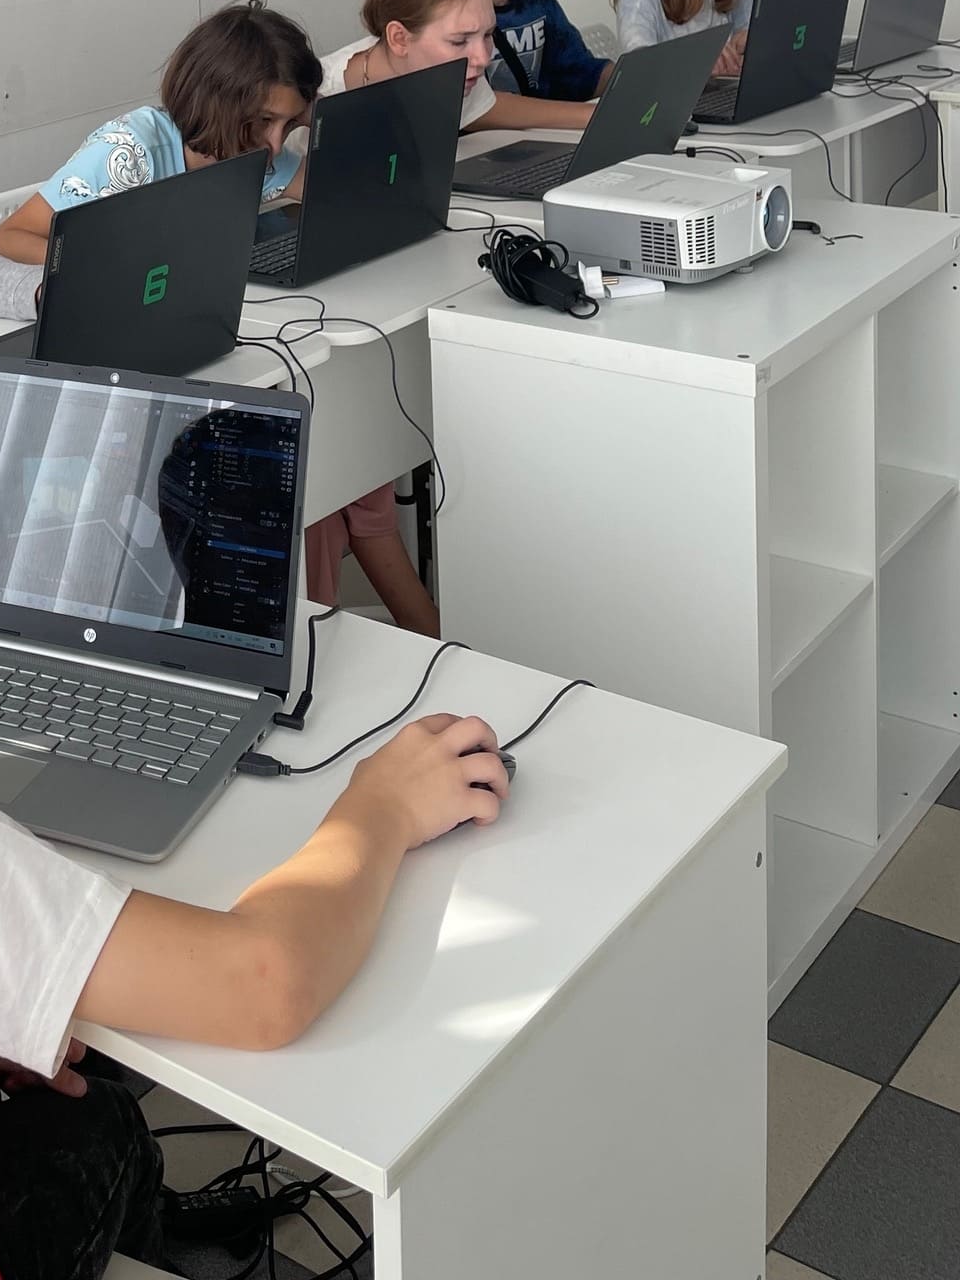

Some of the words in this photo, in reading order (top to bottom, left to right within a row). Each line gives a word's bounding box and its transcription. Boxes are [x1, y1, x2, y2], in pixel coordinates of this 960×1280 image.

[793, 24, 807, 50] 3
[640, 101, 658, 125] 4
[389, 154, 397, 184] 1
[143, 264, 169, 305] 6
[84, 629, 97, 643] hp
